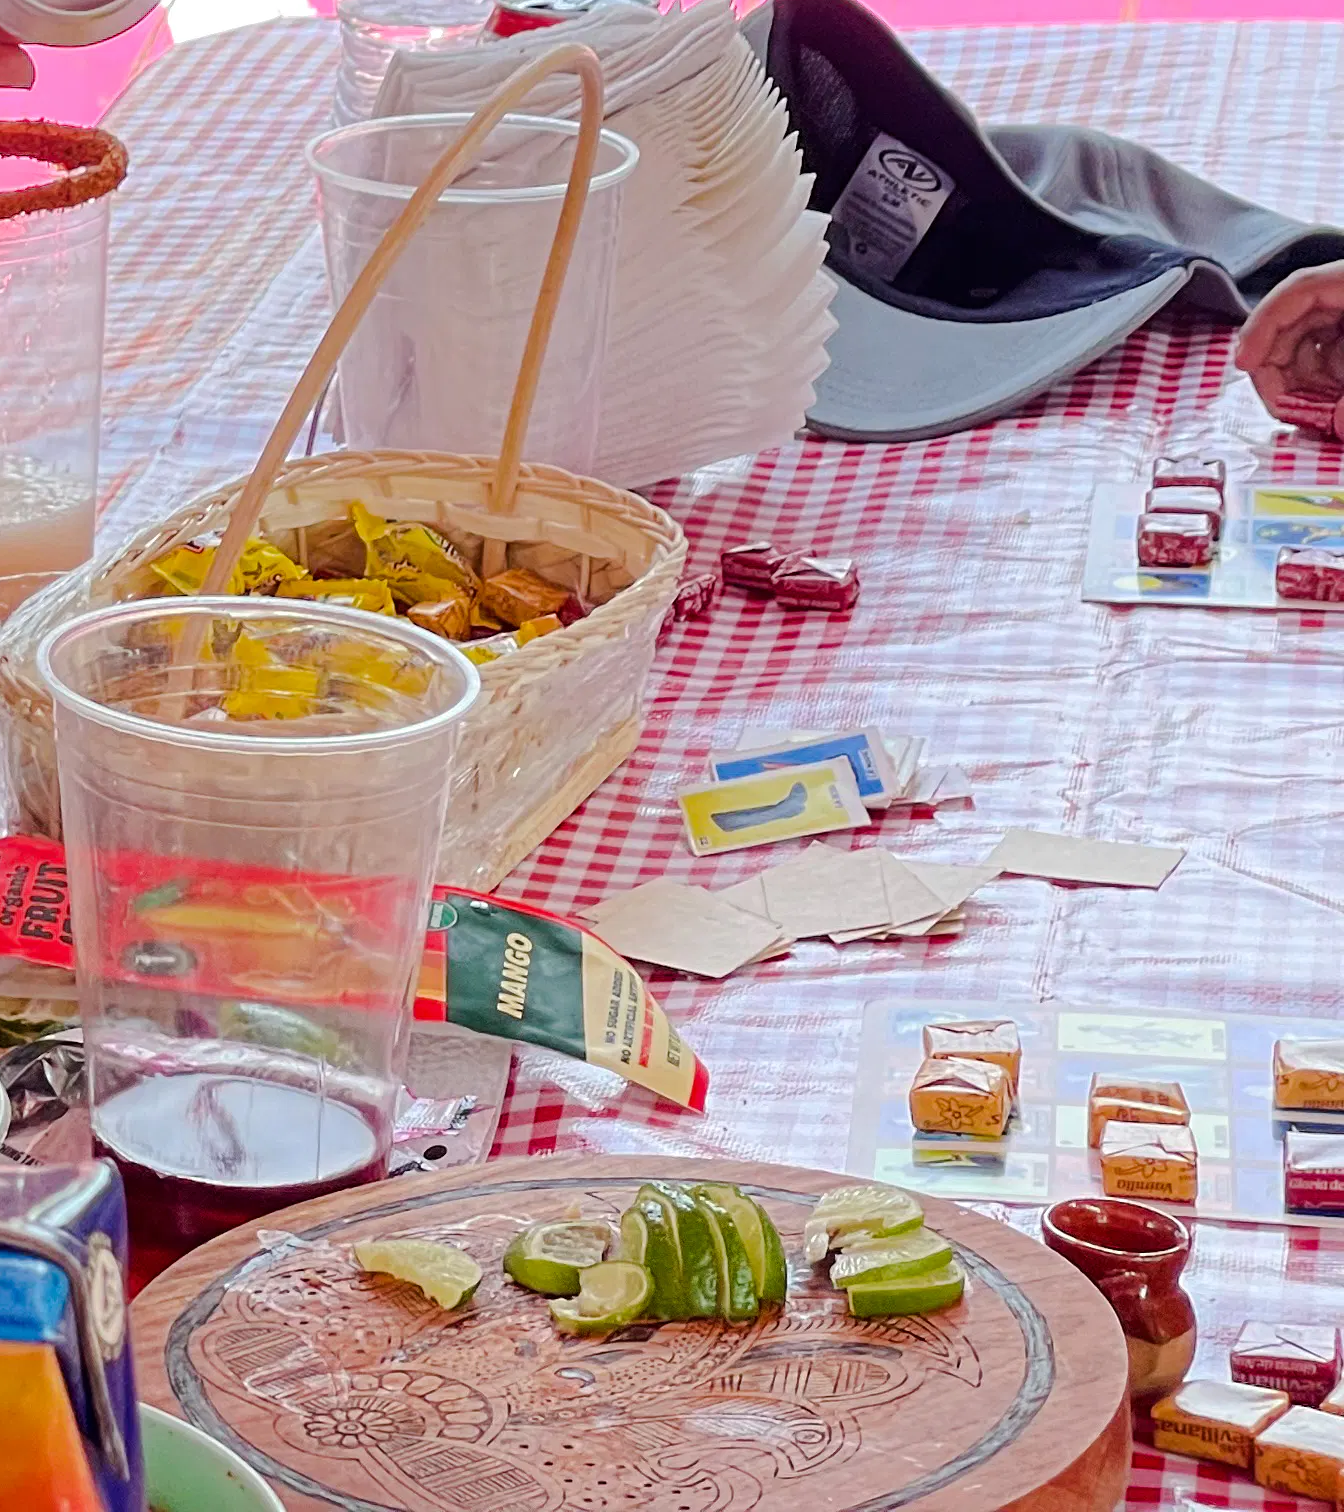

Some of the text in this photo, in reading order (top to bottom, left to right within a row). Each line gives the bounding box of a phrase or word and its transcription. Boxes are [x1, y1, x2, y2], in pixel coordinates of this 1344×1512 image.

[866, 169, 933, 209] ATHLETIC
[20, 861, 69, 940] FRUIT
[496, 932, 533, 1020] MANGO
[620, 1049, 632, 1065] NO
